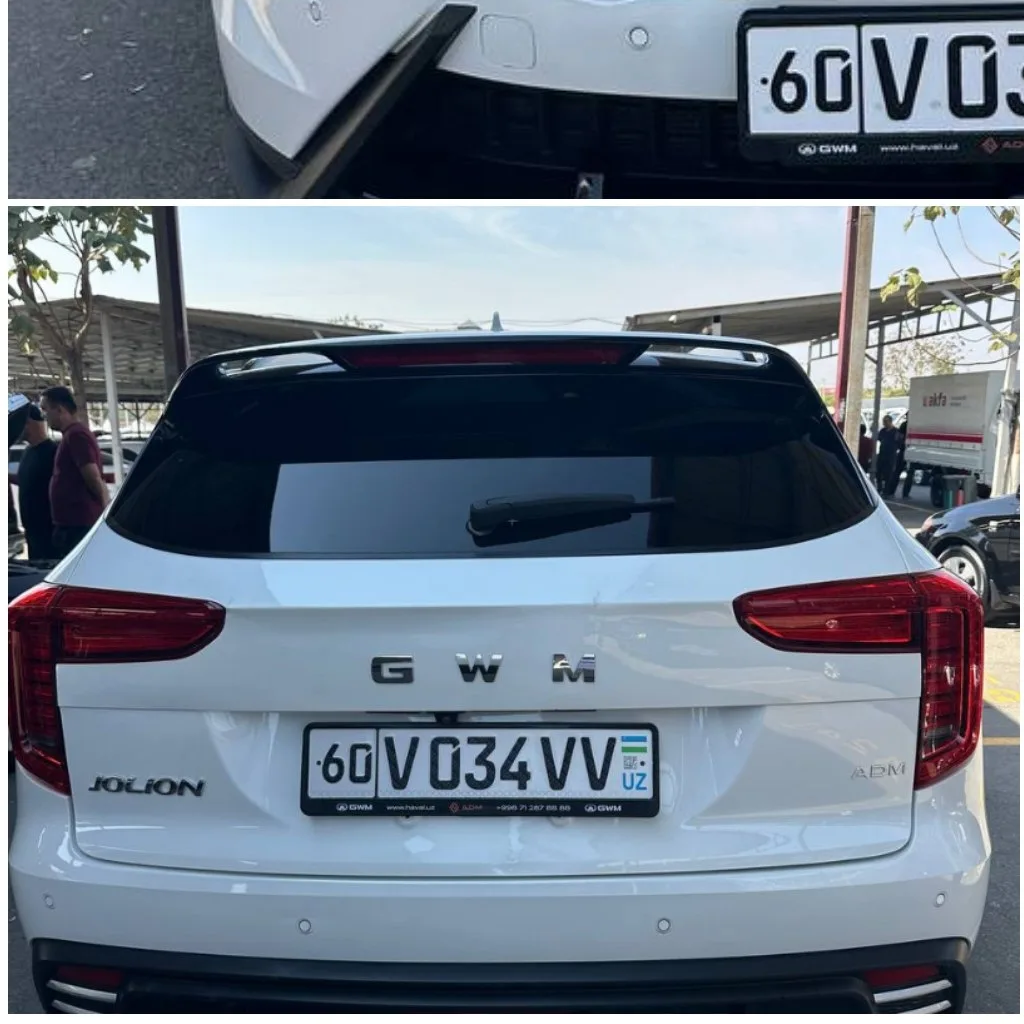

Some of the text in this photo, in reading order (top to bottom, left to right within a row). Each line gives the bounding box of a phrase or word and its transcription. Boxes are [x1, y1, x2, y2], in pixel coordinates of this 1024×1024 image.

[770, 49, 853, 114] 60
[819, 143, 858, 154] GWM
[321, 743, 373, 784] 60
[850, 762, 907, 780] ADM
[88, 776, 206, 797] JOLION
[622, 772, 648, 791] UZ
[349, 804, 374, 812] GWM
[597, 804, 622, 812] GWM
